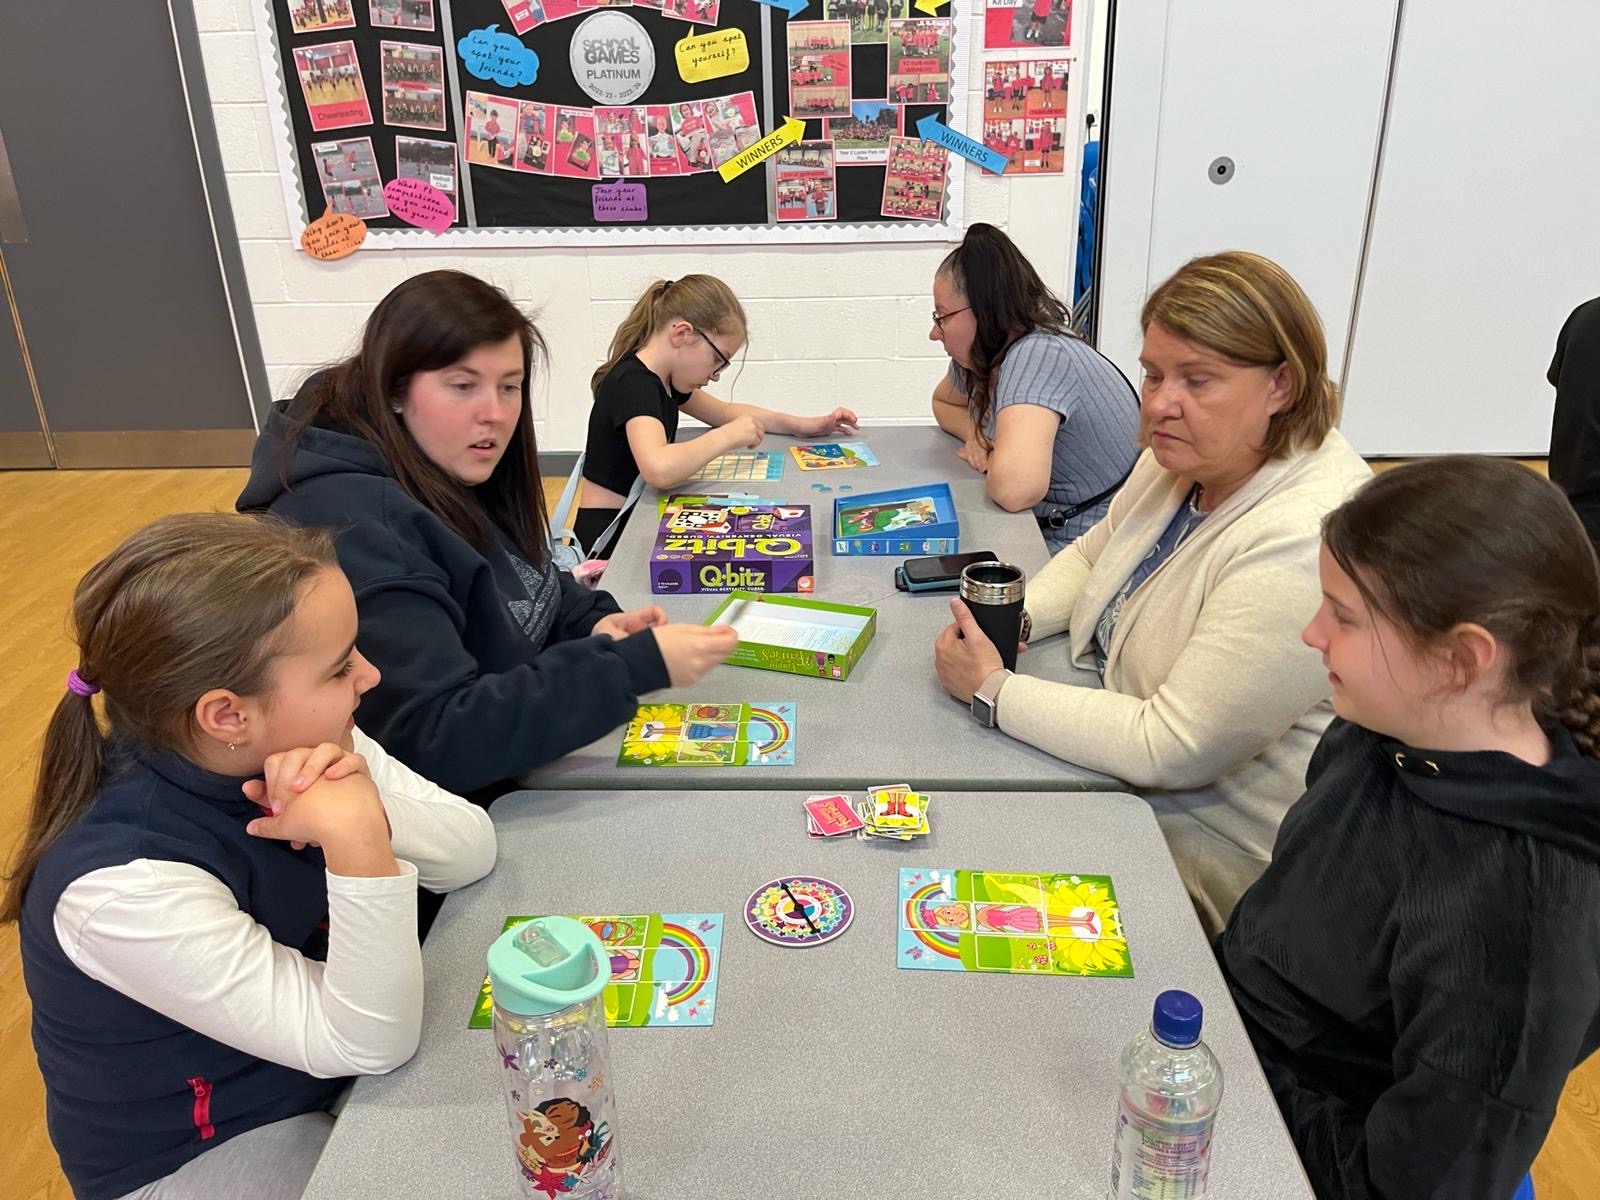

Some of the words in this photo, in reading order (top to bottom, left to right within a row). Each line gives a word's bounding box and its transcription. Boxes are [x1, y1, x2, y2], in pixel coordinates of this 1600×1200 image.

[472, 36, 488, 46] Can
[494, 44, 510, 52] you
[583, 37, 640, 50] SCHOOL
[680, 44, 696, 52] Can
[701, 40, 718, 52] you
[722, 34, 742, 44] spot
[470, 50, 492, 59] spot
[498, 56, 521, 65] your
[584, 50, 640, 64] GAMES
[586, 69, 641, 79] PLATINUM
[736, 134, 784, 168] WINNERS
[942, 130, 988, 162] WINNERS
